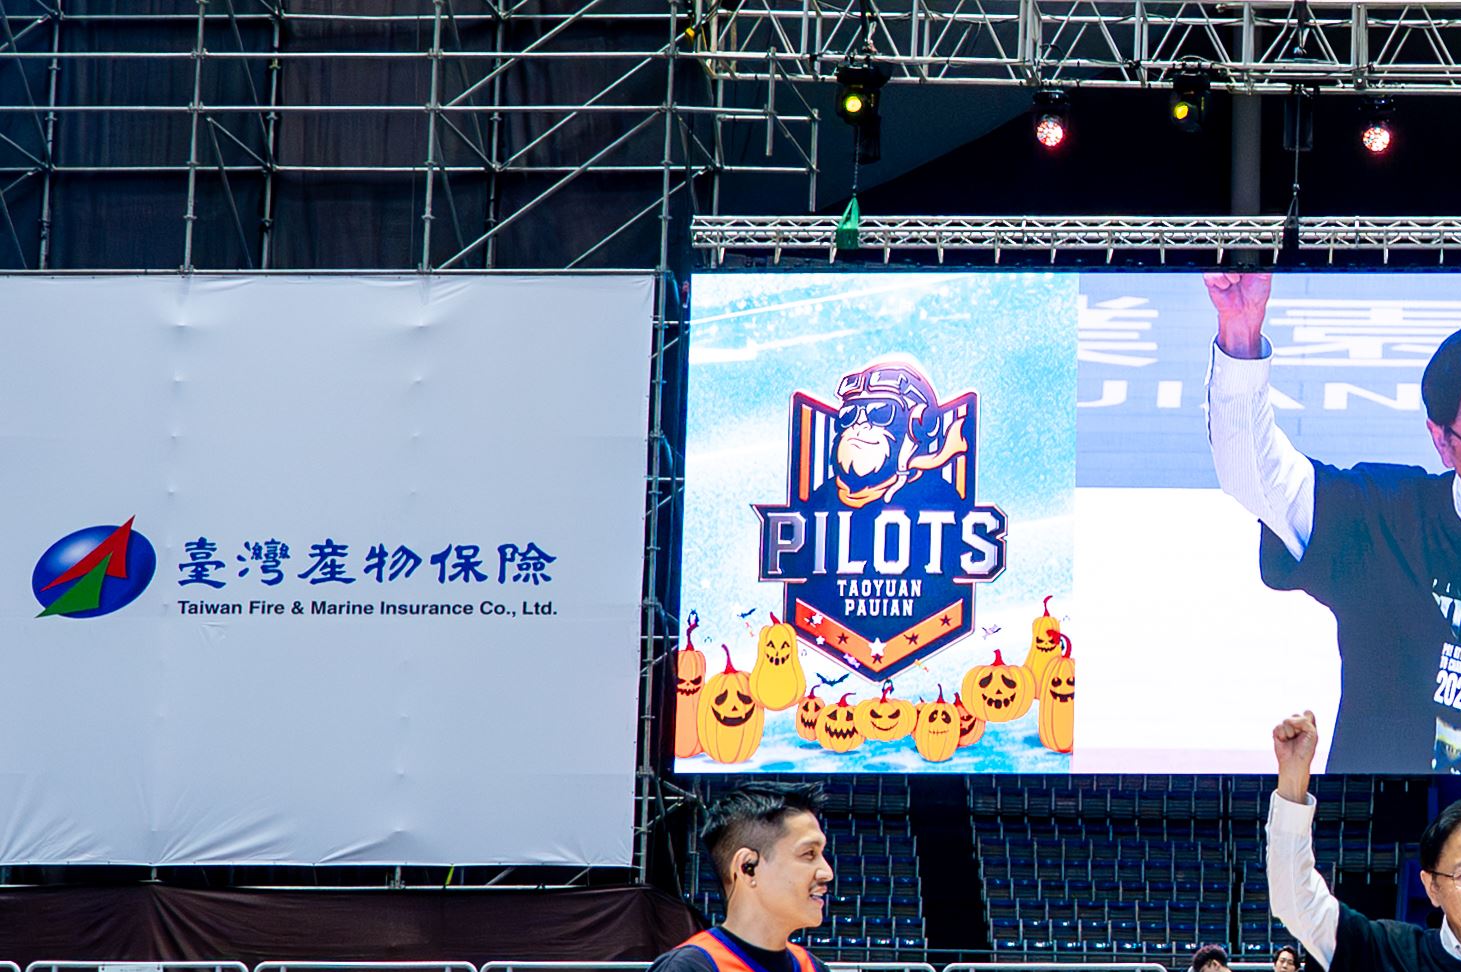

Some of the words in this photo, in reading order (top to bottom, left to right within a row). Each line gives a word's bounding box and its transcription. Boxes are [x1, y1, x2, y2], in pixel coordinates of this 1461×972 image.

[767, 510, 1000, 575] PILOTS
[836, 579, 922, 598] TAOYUAN
[177, 600, 243, 615] Taiwan
[248, 600, 285, 615] Fire
[290, 600, 305, 615] &
[310, 600, 375, 615] Marine
[380, 600, 474, 616] Insurance
[480, 600, 517, 618] Co.,
[523, 600, 558, 616] Ltd.
[844, 599, 914, 617] PAUIAN
